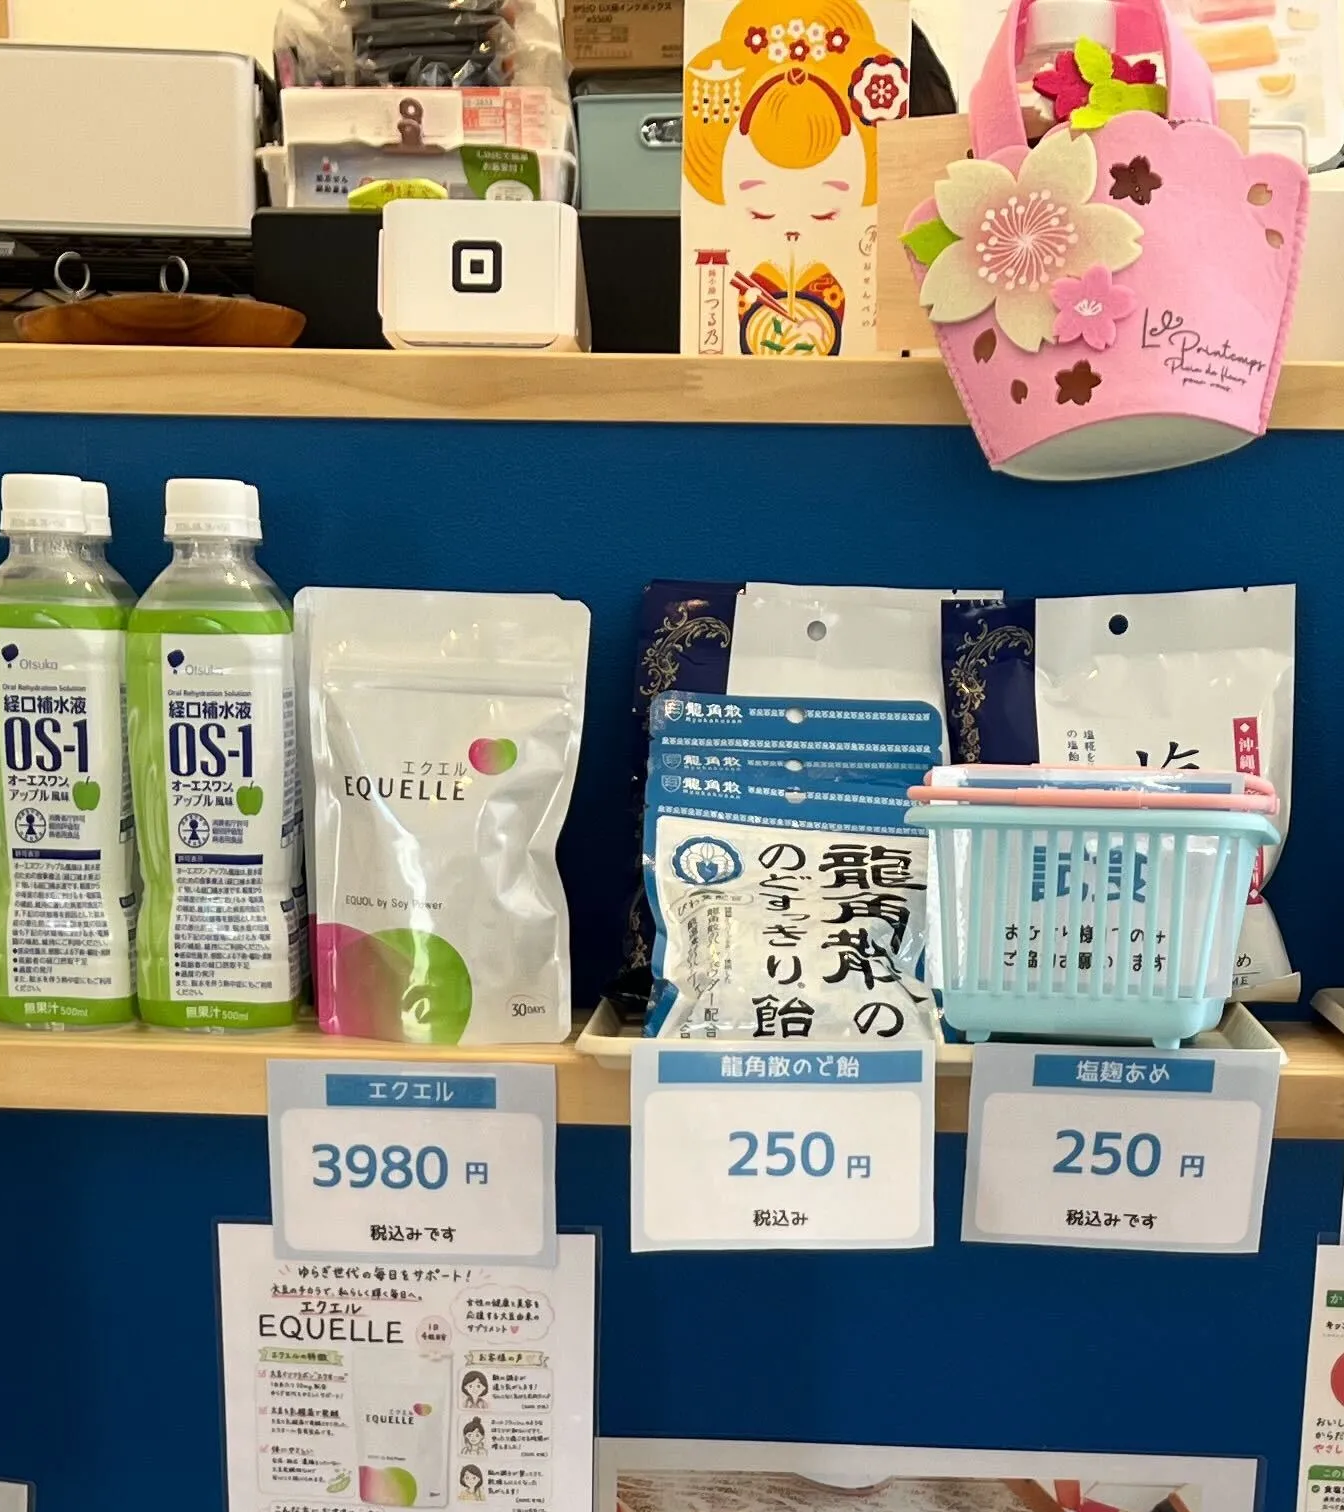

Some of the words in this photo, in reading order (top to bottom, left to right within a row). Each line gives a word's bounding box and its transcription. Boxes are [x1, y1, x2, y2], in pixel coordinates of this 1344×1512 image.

[3, 695, 86, 714] 経口補水液
[168, 701, 251, 720] 経口補水液
[685, 702, 743, 718] 龍角散
[4, 717, 89, 773] OS-1
[168, 722, 253, 778] OS-1
[402, 760, 467, 777] エクエル
[344, 775, 465, 801] EQUELLE
[682, 777, 741, 792] 龍角散
[721, 1055, 861, 1079] 龍角散のど飴
[368, 1080, 454, 1102] エクエル
[727, 1130, 836, 1179] 250
[846, 1155, 871, 1179] 円
[1051, 1129, 1160, 1177] 250
[1179, 1155, 1205, 1179] 円
[311, 1143, 450, 1191] 3980
[466, 1161, 489, 1185] 円
[752, 1209, 809, 1228] 税込み
[1065, 1208, 1158, 1229] 税込みです
[370, 1224, 457, 1243] 税込みです
[301, 1301, 362, 1315] エクエル
[258, 1314, 404, 1344] EQUELLE
